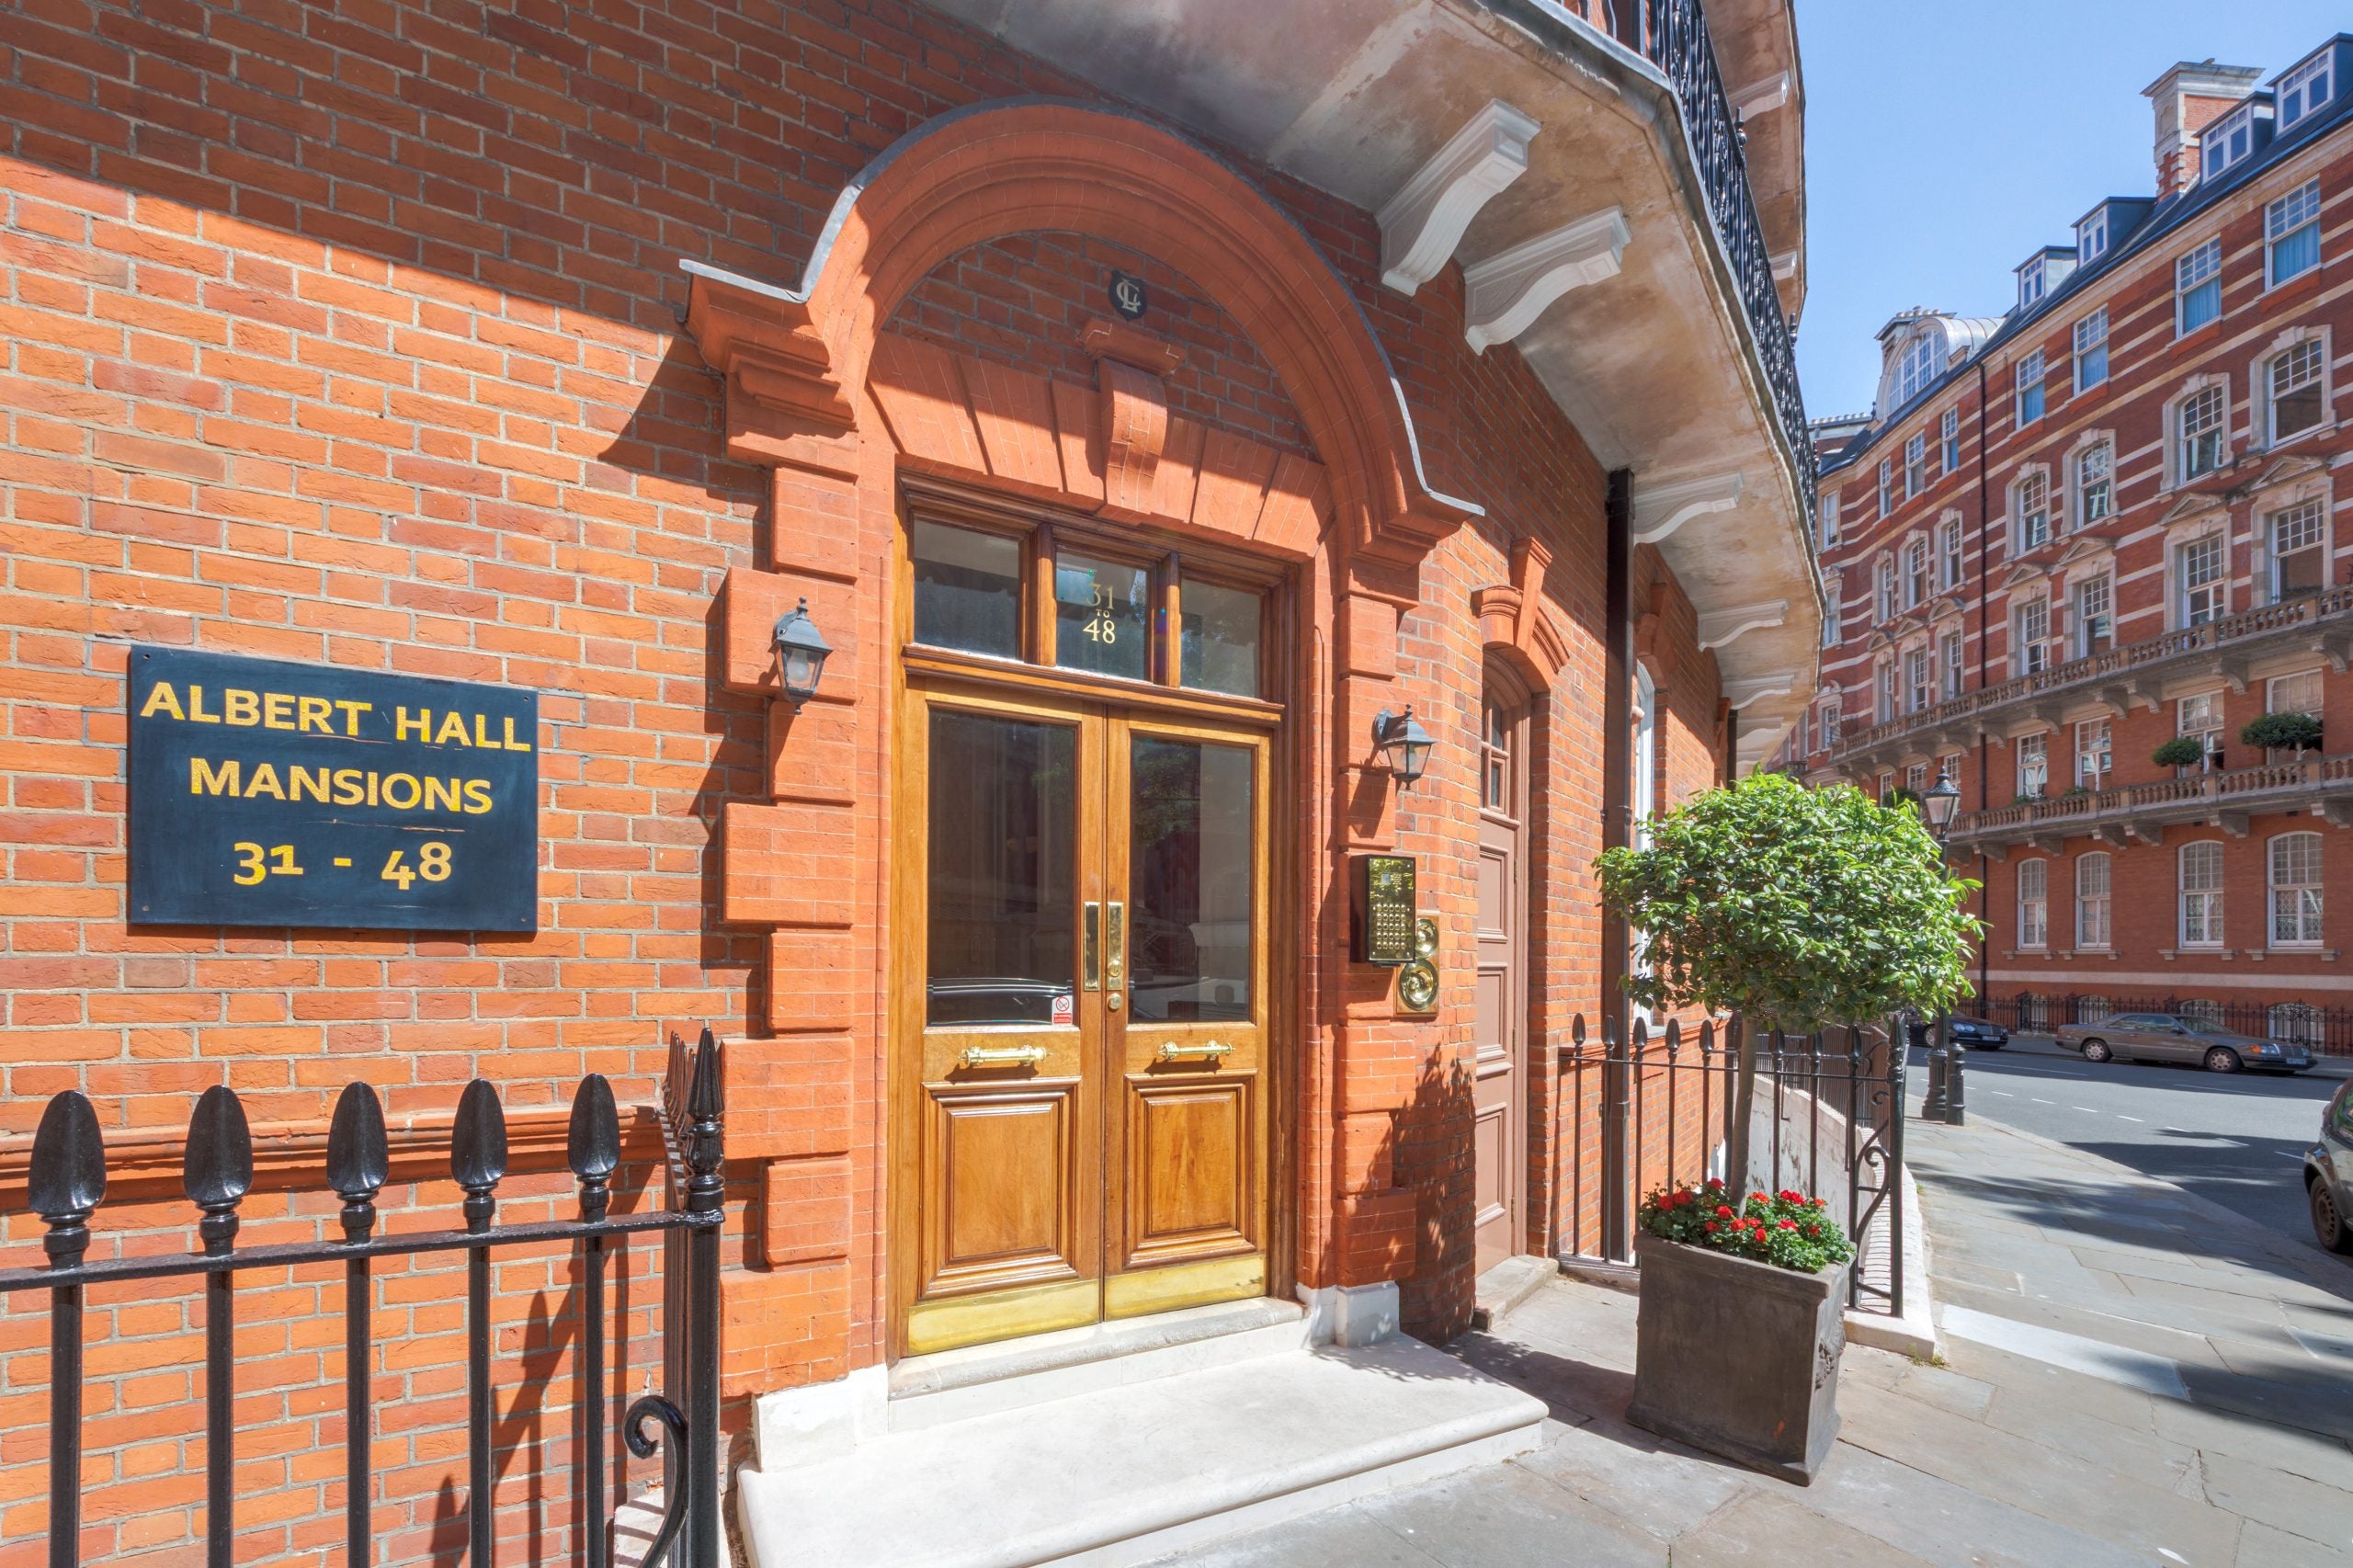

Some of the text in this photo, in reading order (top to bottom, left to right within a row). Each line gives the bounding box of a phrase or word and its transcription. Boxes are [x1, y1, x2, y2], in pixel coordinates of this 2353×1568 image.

[1086, 582, 1115, 609] 31
[1096, 608, 1110, 619] TO
[1083, 618, 1116, 644] 48
[140, 682, 531, 752] ALBERT HALL
[190, 757, 493, 814] MANSIONS
[233, 842, 304, 885] 31
[381, 842, 452, 890] 48
